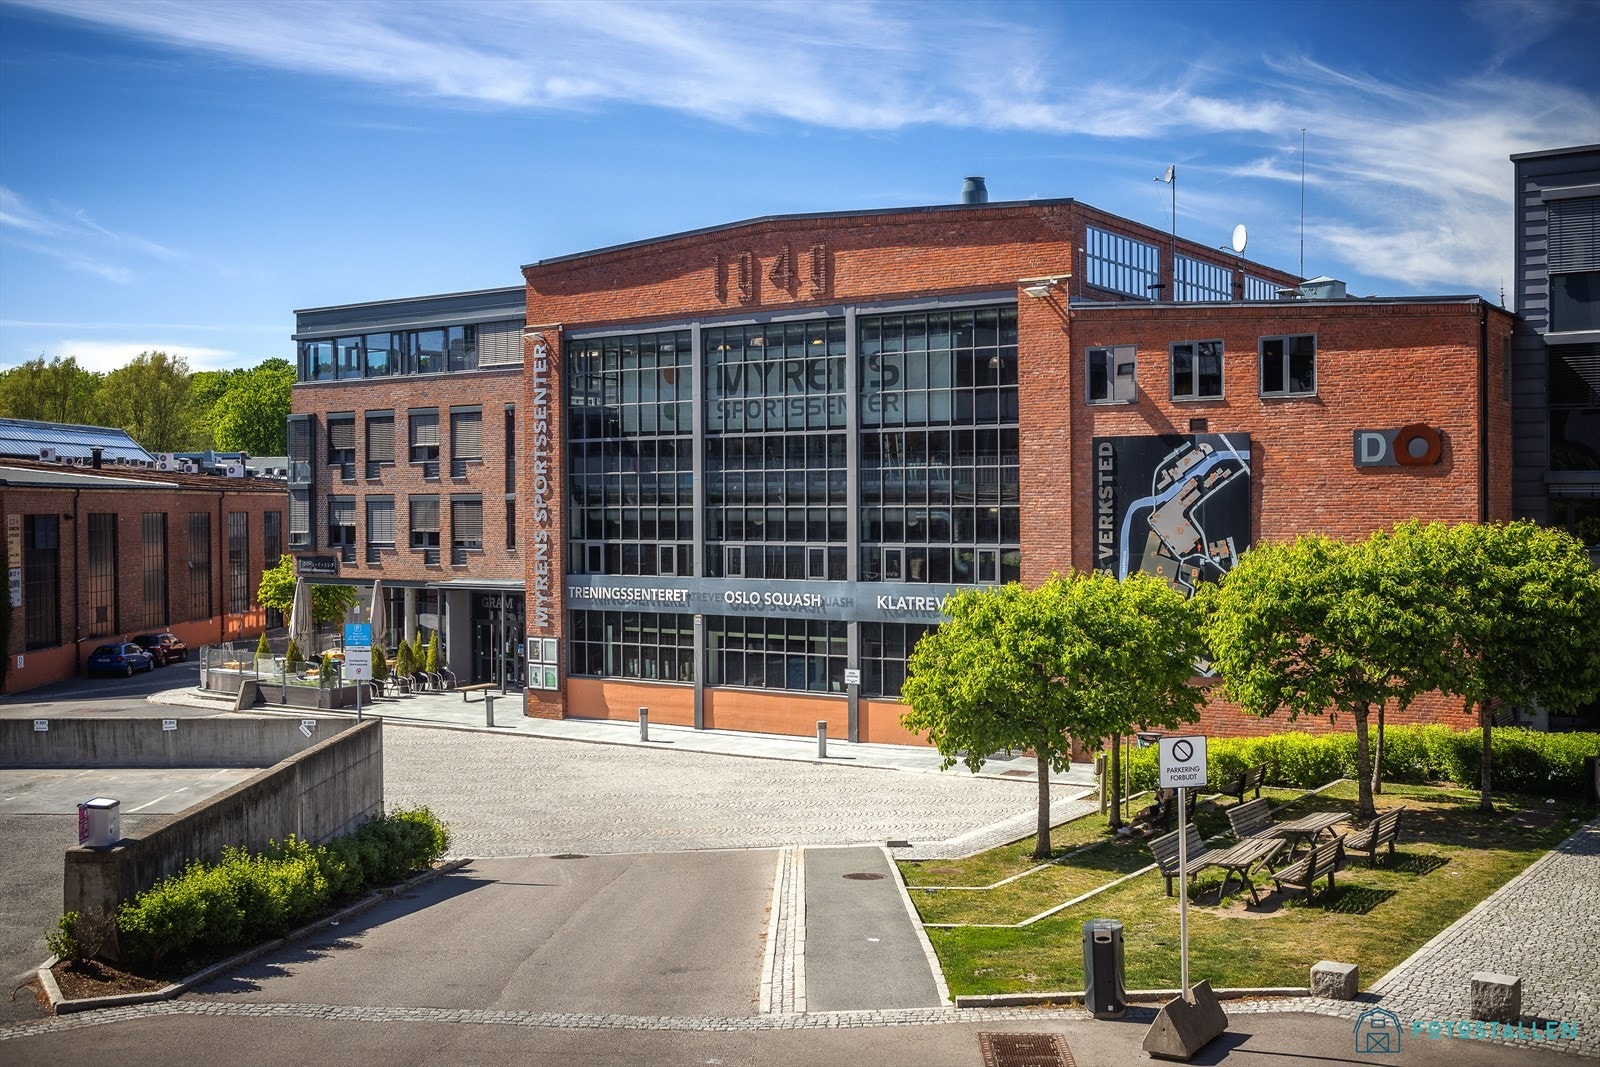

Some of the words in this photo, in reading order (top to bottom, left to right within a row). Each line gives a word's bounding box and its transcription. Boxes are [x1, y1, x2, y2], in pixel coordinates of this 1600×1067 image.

[533, 344, 548, 523] SPORTSSENTER
[1098, 442, 1113, 560] VERKSTED
[534, 529, 549, 627] MYRENS
[568, 586, 689, 602] TRENINGSSENTERET
[724, 590, 760, 605] OSLO
[764, 592, 821, 607] SQUASH
[877, 595, 946, 611] KLATREV
[1167, 766, 1200, 774] PARKERING
